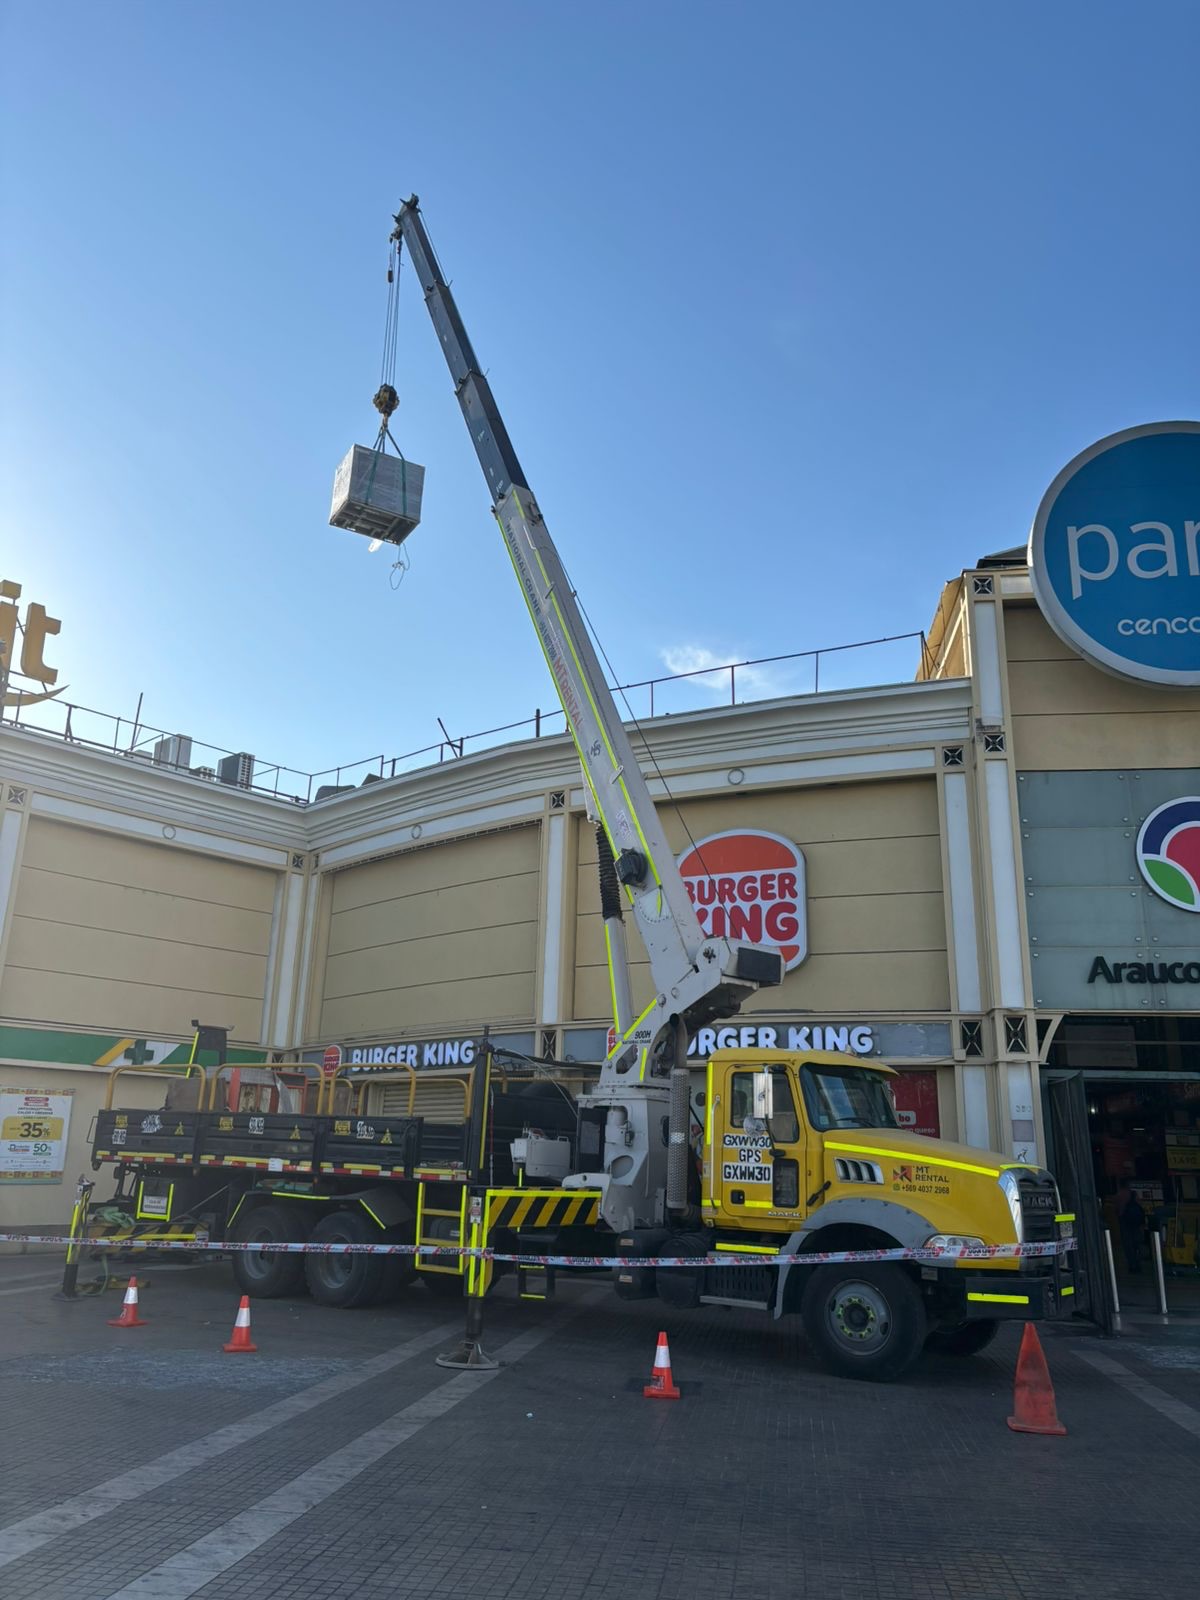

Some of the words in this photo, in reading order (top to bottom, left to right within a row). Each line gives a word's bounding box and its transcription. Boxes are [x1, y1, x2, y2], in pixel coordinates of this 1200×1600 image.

[1087, 955, 1200, 984] Arauco
[351, 1044, 417, 1072] BURGER
[422, 1040, 474, 1066] KING
[739, 1149, 762, 1162] GPS
[723, 1164, 771, 1182] GXWW30
[915, 1165, 930, 1174] MT
[915, 1174, 950, 1183] RENTAL
